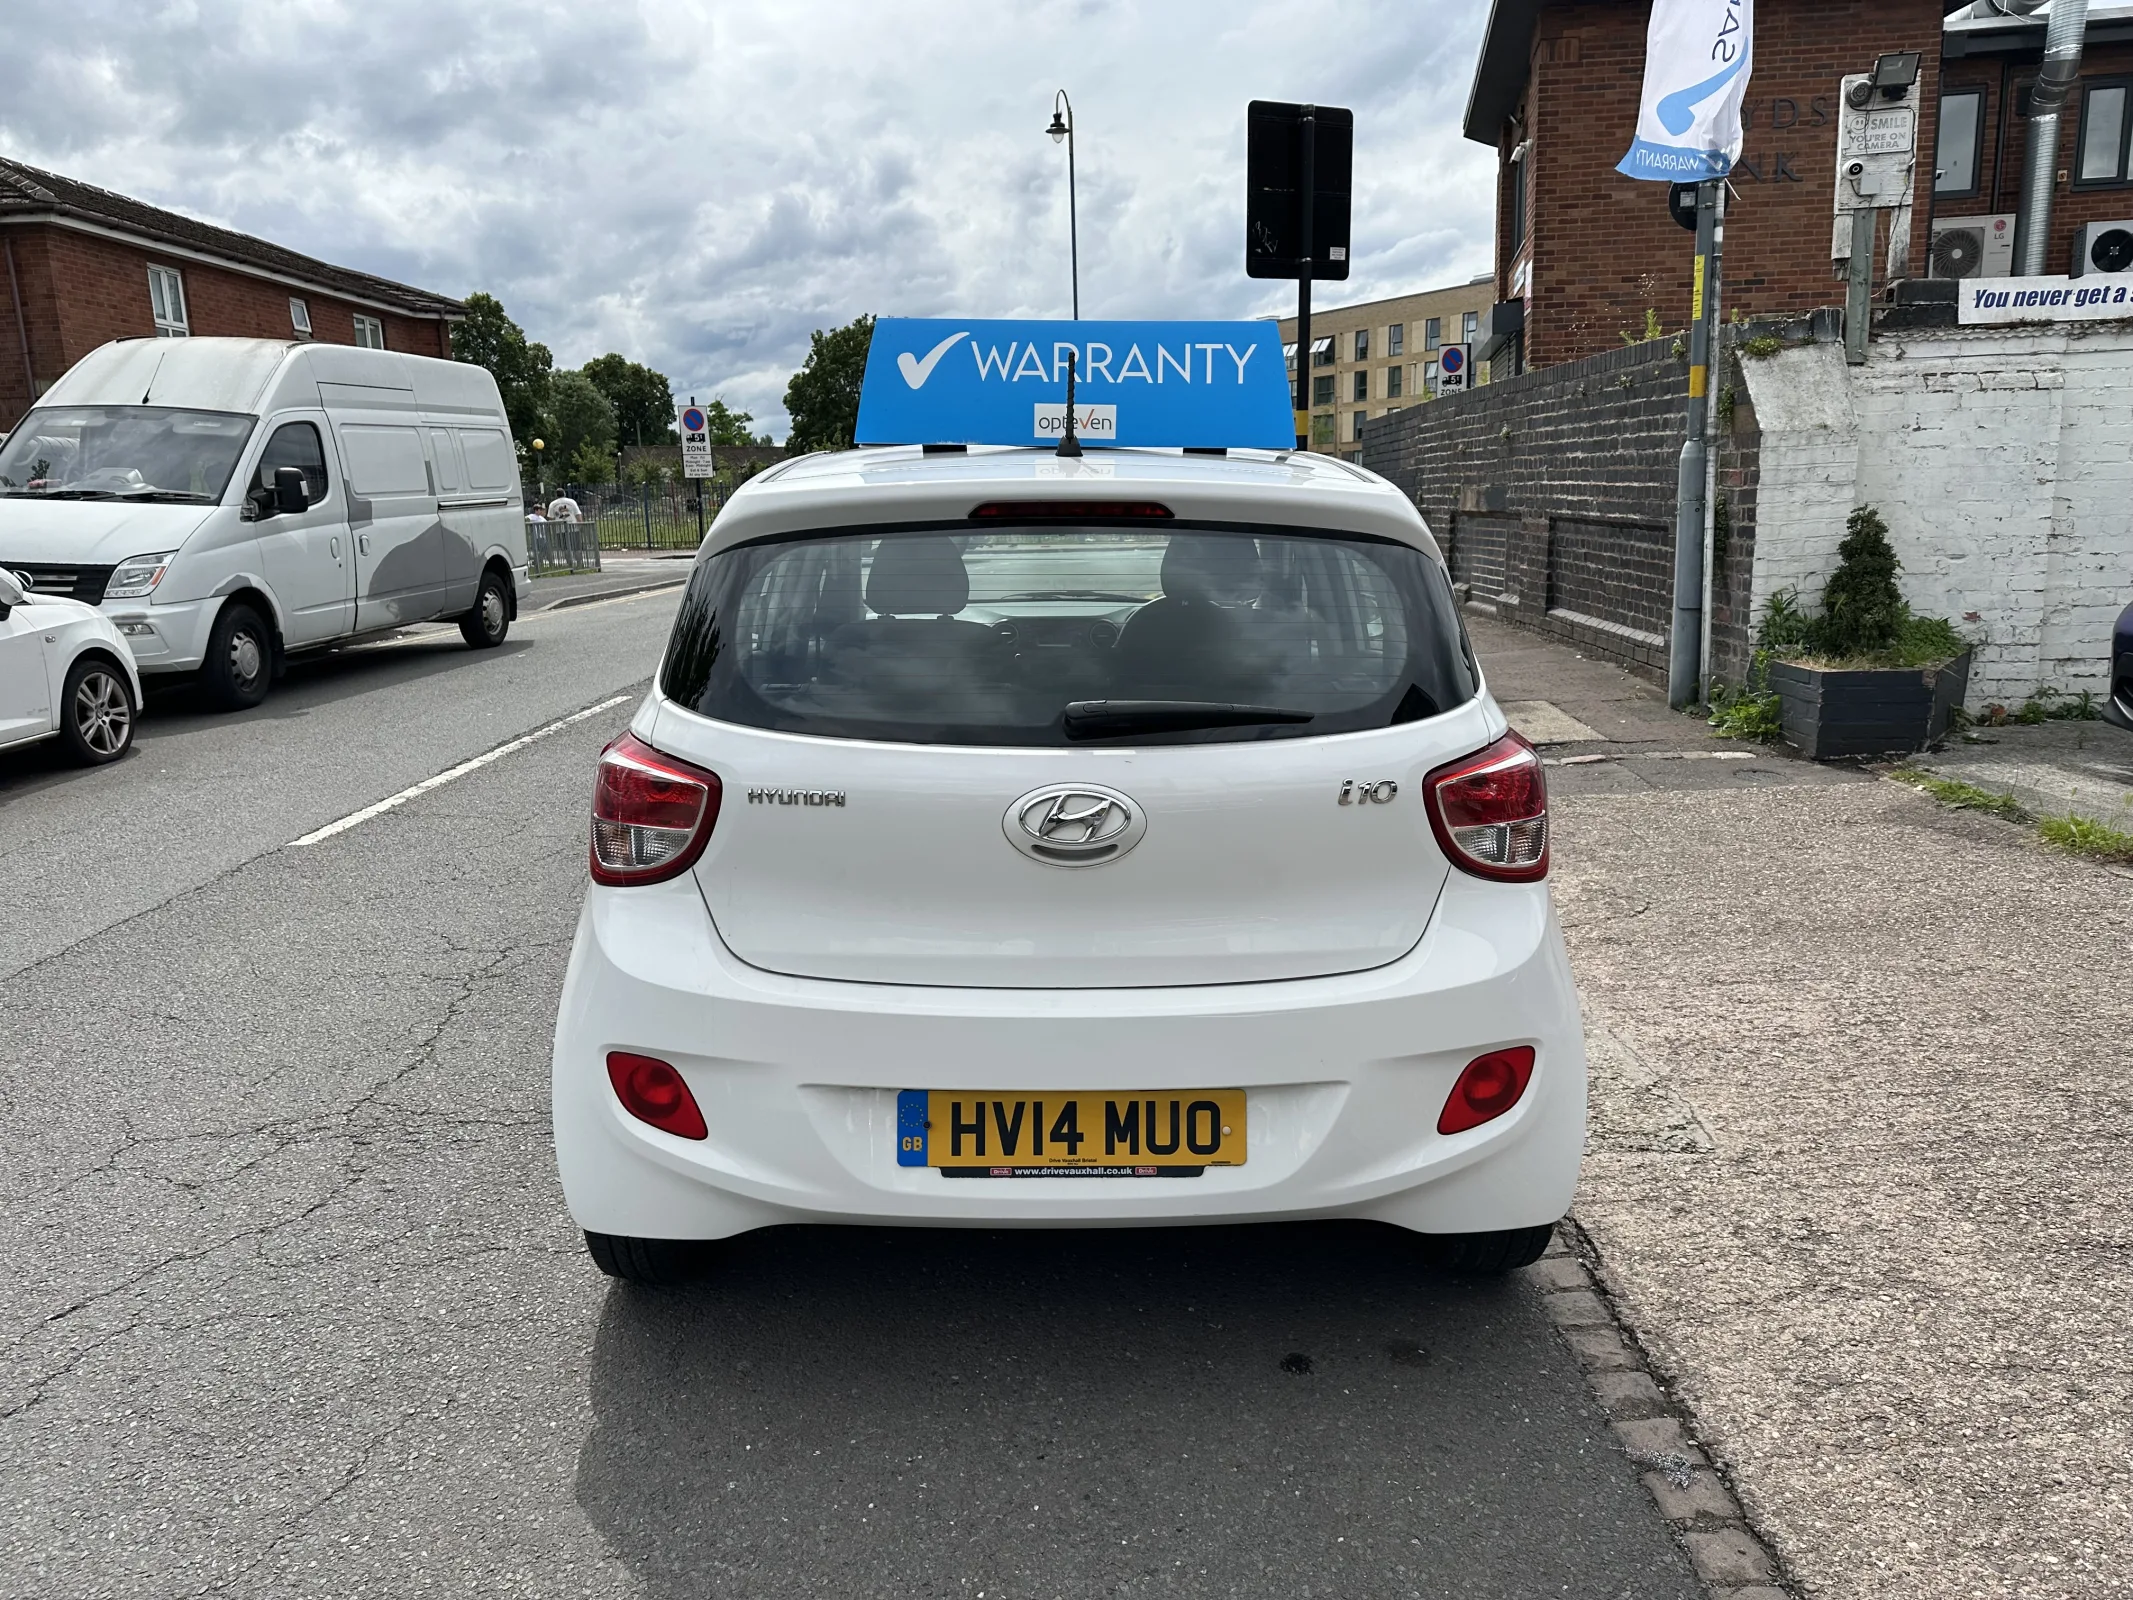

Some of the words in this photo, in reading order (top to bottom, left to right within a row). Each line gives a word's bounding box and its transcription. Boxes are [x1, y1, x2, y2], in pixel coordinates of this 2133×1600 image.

[1740, 97, 1829, 130] YDS
[1871, 117, 1907, 130] SMILE
[1850, 133, 1887, 143] YOU'RE
[1890, 132, 1906, 141] ON
[1857, 141, 1899, 150] CAMERA
[1974, 289, 2010, 308] You
[2012, 289, 2073, 307] never
[2074, 286, 2111, 307] get
[2113, 287, 2127, 303] a
[971, 341, 1257, 384] WARRANTY
[748, 787, 846, 807] HYUNDAI
[1338, 778, 1398, 806] i10
[951, 1101, 1084, 1156] HV14
[1104, 1100, 1221, 1156] MUO
[902, 1136, 923, 1151] GB
[1015, 1167, 1132, 1175] www.drivevauxhall.co.uk
